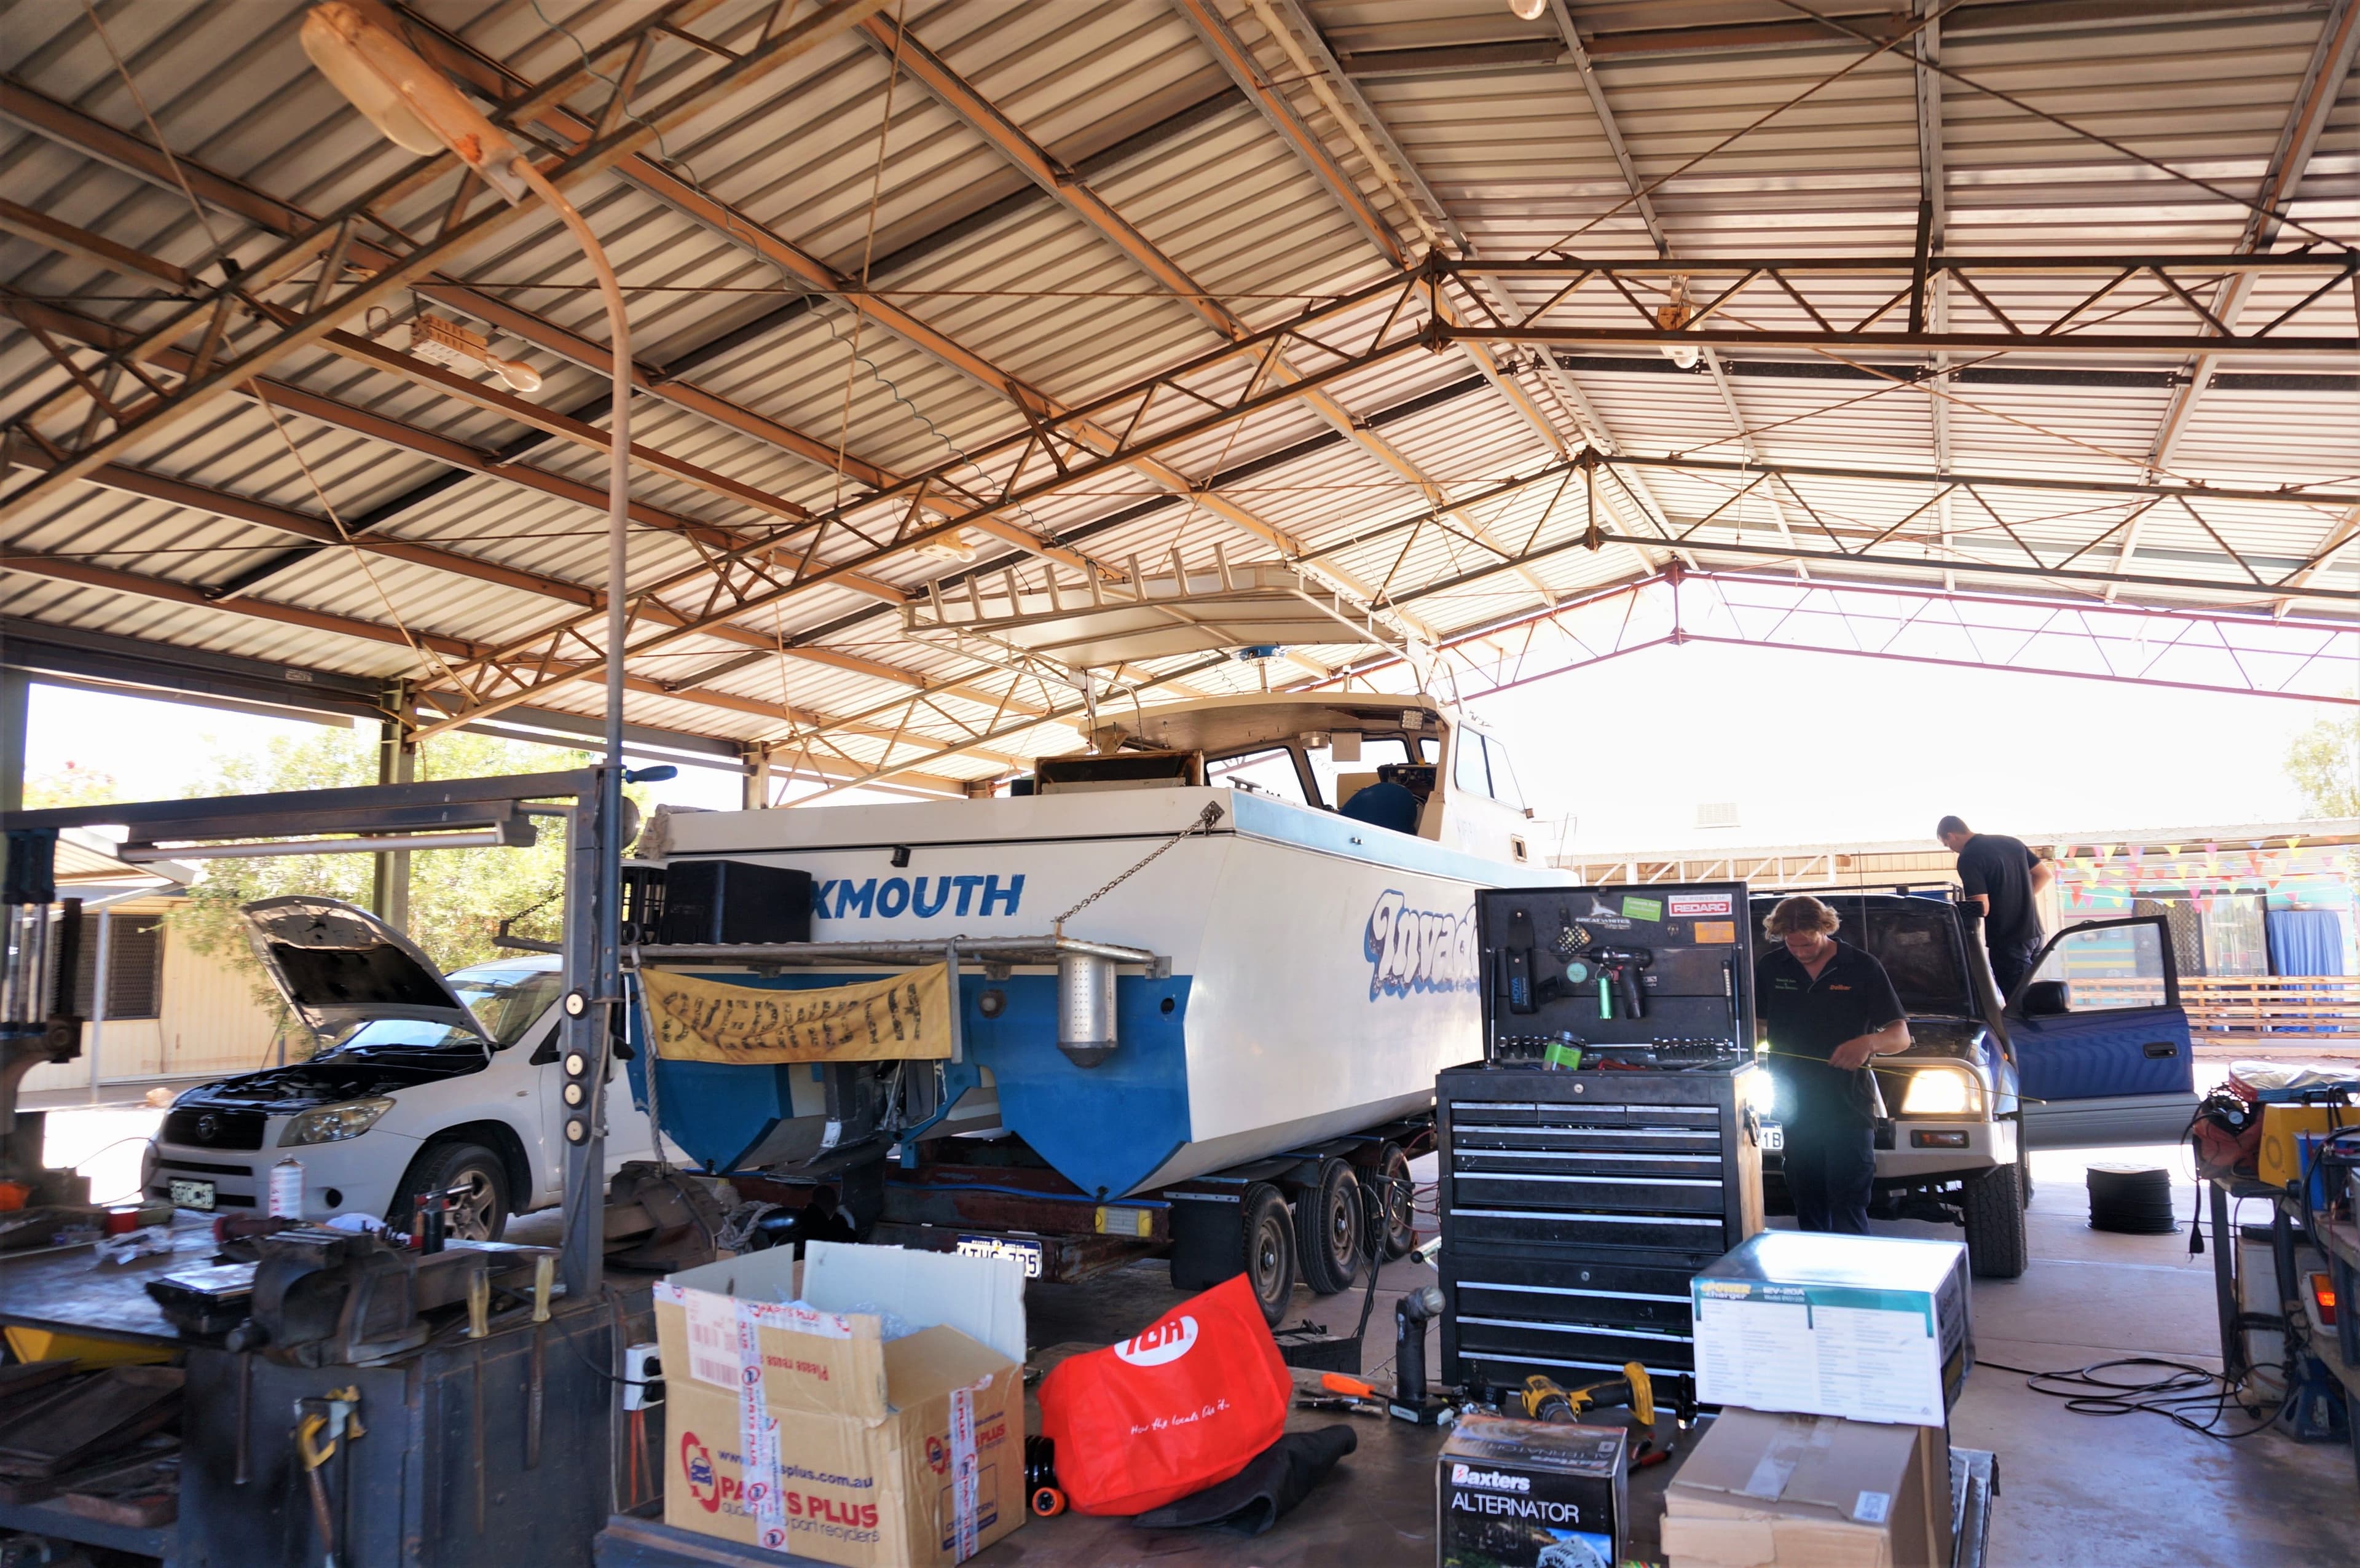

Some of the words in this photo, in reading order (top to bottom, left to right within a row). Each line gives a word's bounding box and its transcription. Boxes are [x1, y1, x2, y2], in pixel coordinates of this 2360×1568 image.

[811, 874, 1026, 920] XMOUTH
[1674, 903, 1727, 912] REDARC
[1363, 888, 1480, 1003] Invad
[1511, 978, 1520, 1003] HOYA
[1452, 1463, 1530, 1491] Baxters
[808, 1495, 879, 1529] PLUS
[1452, 1491, 1579, 1524] ALTERNATOR
